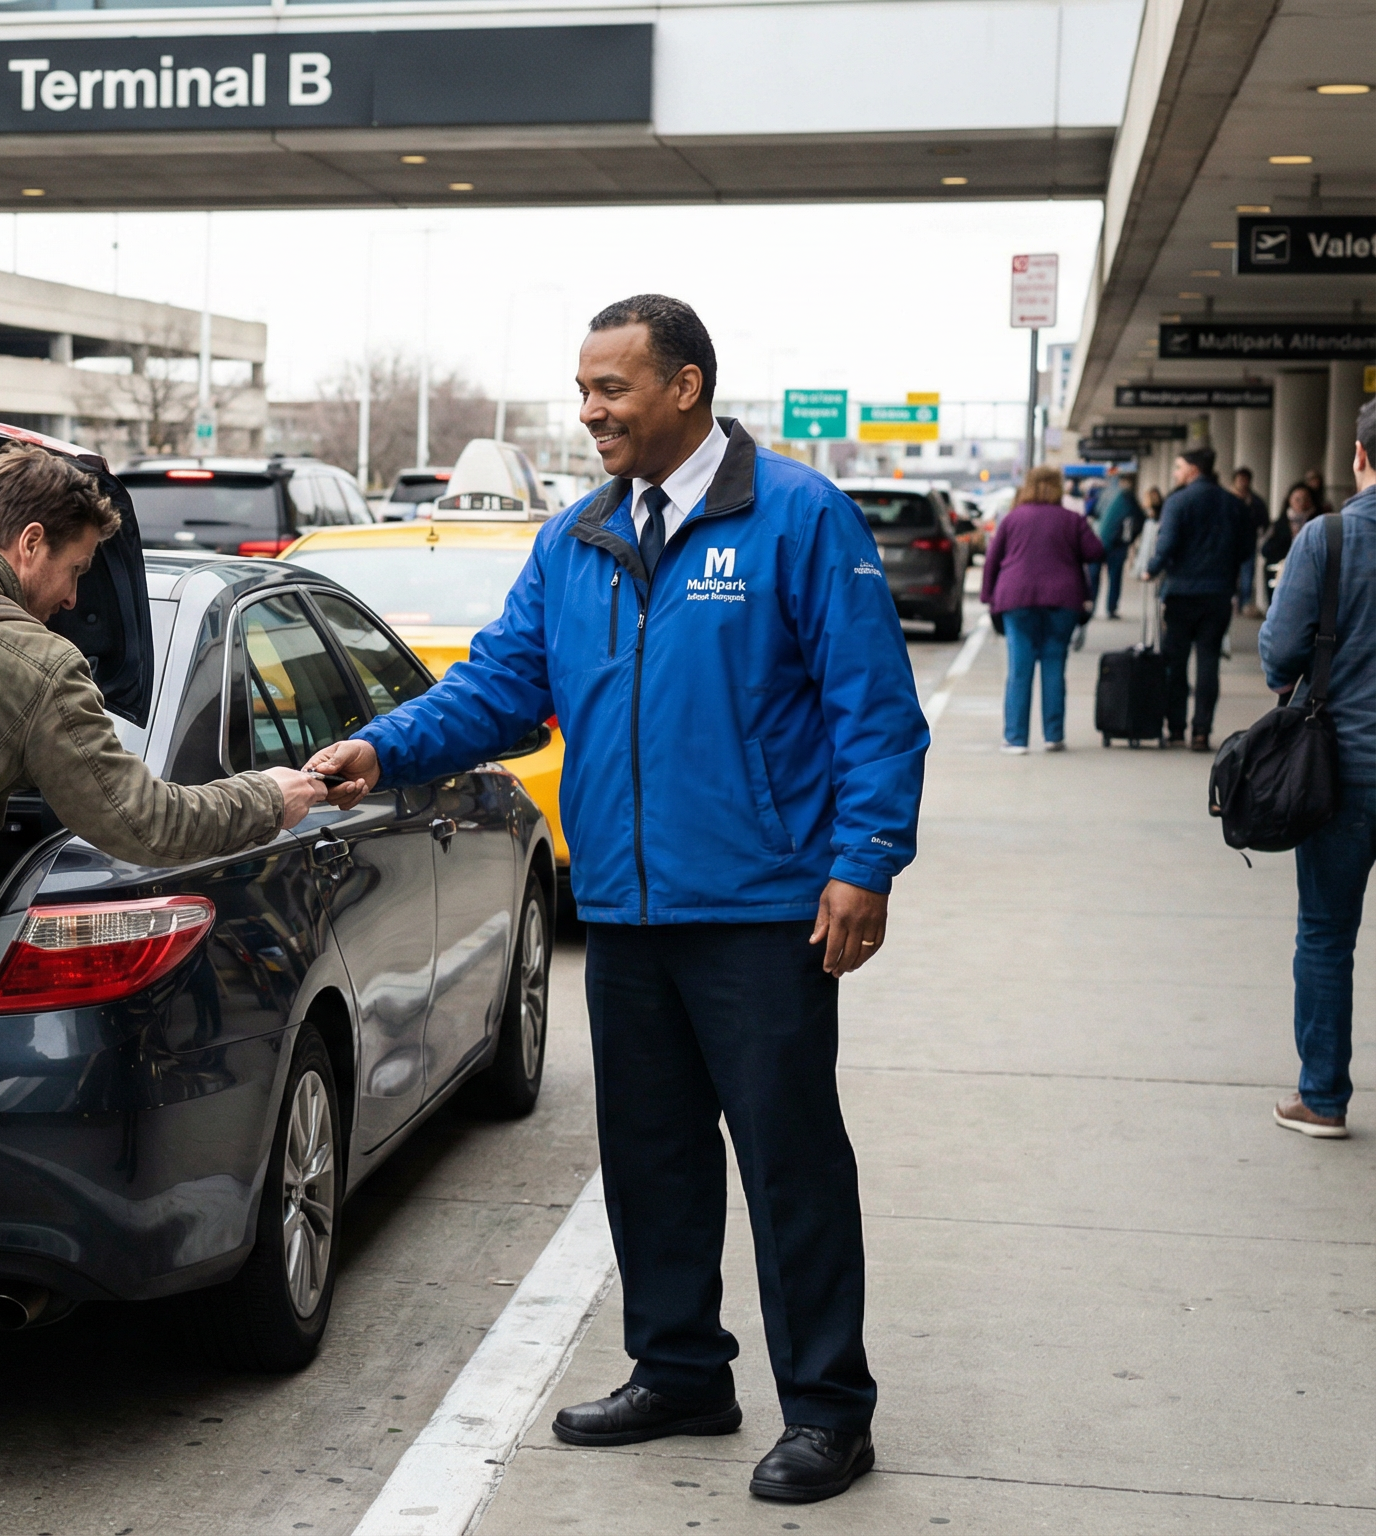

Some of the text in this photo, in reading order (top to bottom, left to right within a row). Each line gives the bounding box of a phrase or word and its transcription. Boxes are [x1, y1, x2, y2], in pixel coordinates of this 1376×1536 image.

[8, 53, 267, 112] Terminal
[288, 52, 333, 107] B
[1198, 332, 1284, 353] Multipark
[704, 547, 736, 578] M
[686, 578, 747, 593] Multipark
